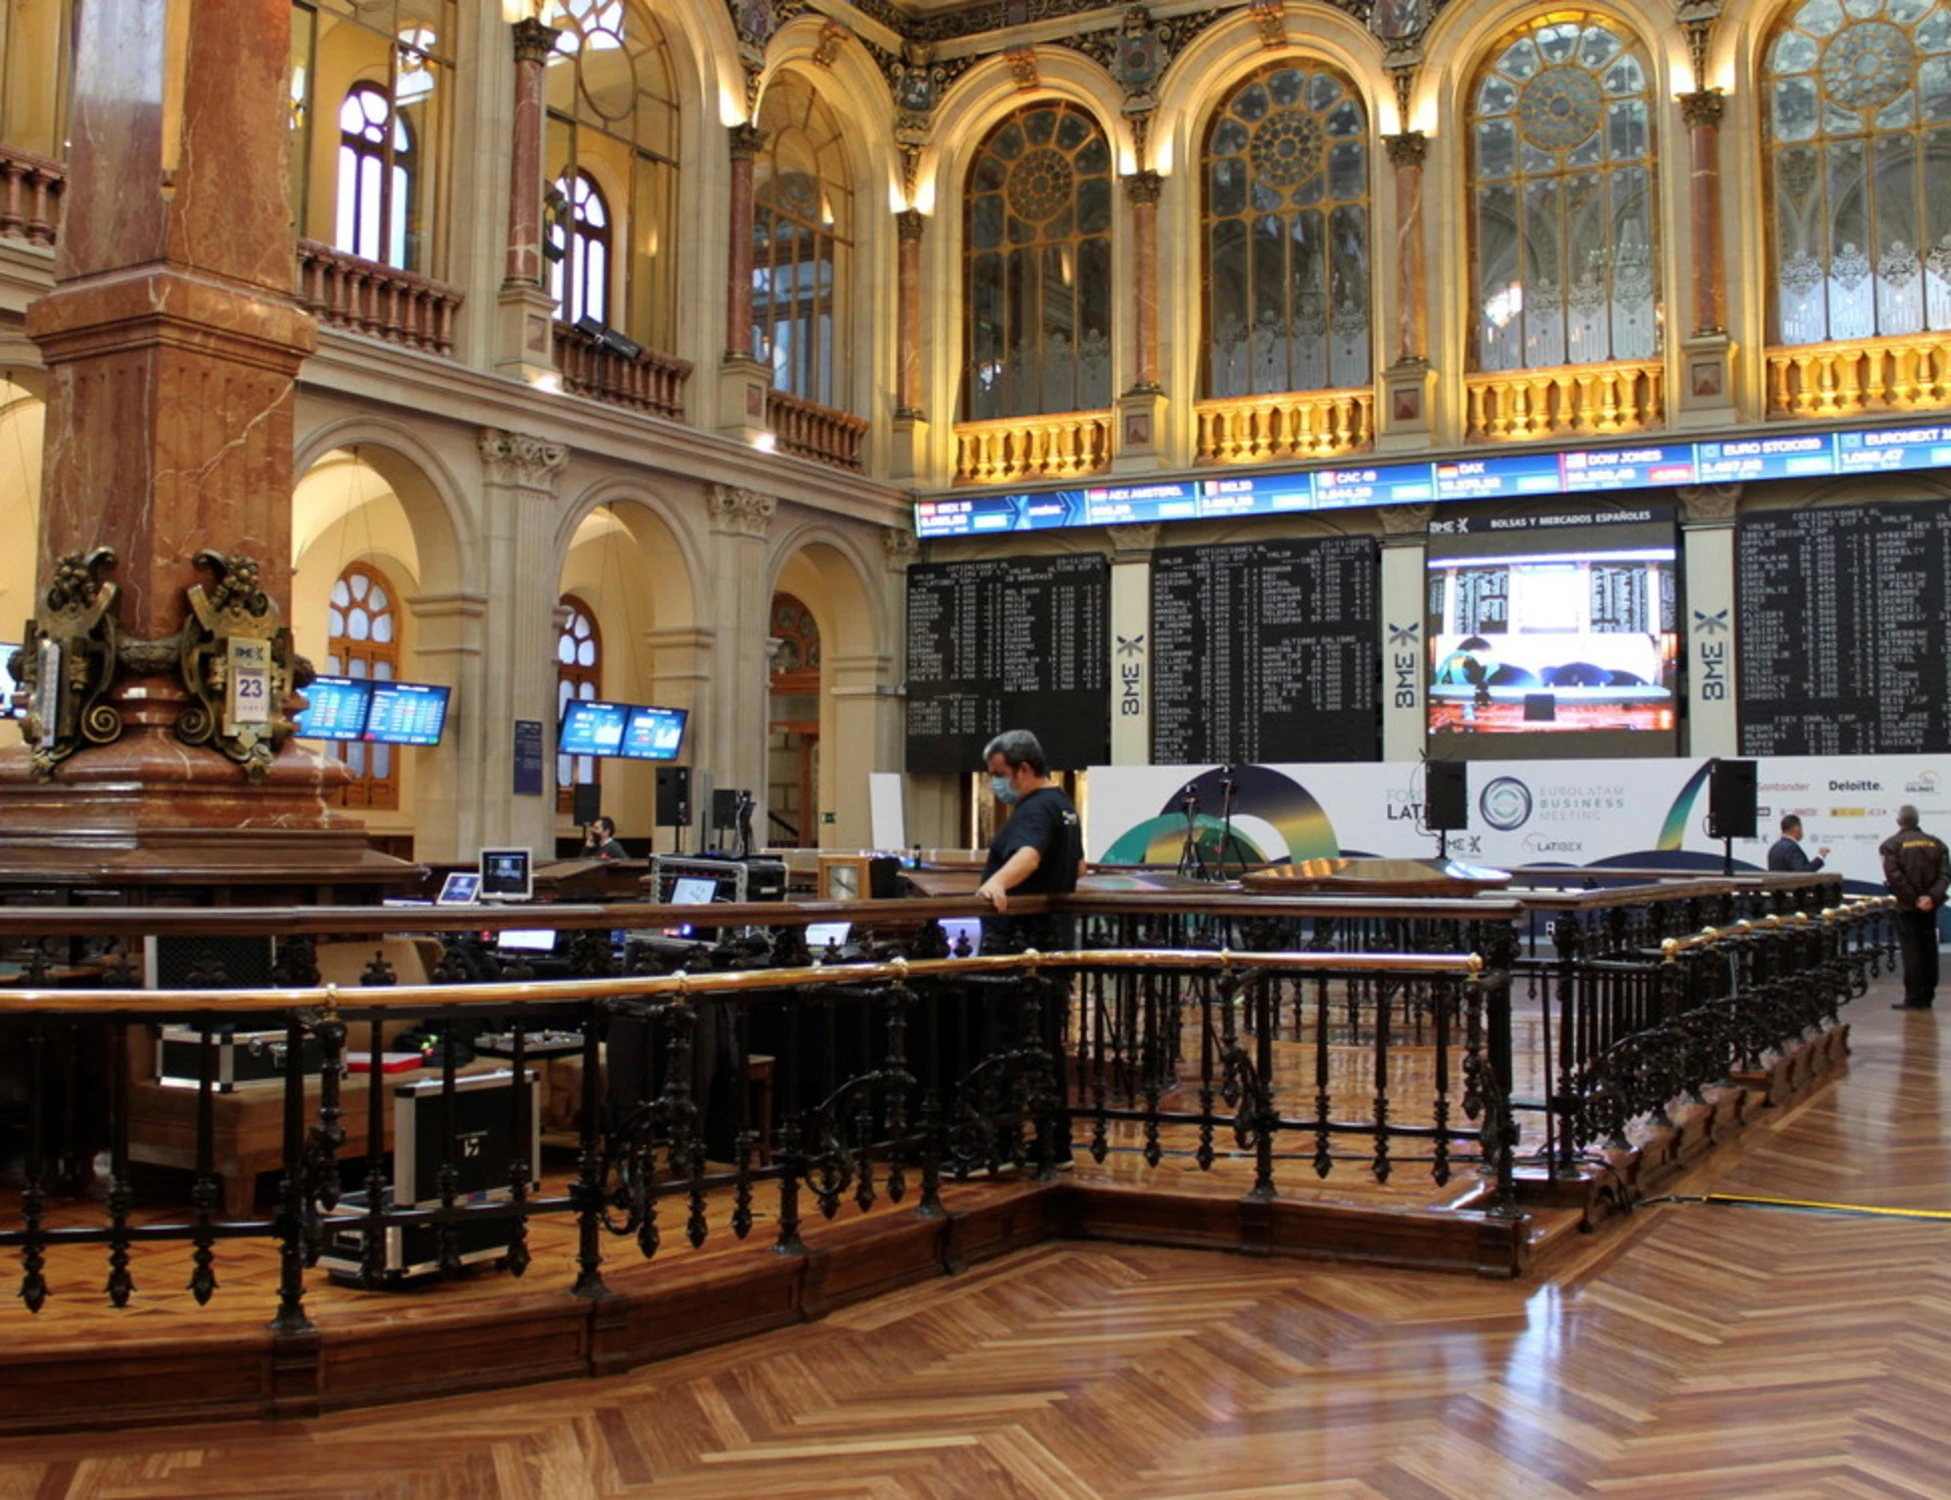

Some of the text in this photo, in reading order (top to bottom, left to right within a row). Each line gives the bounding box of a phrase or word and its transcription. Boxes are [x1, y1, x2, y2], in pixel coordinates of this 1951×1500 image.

[1491, 517, 1527, 529] BOLSAS
[1530, 516, 1537, 526] Y
[1539, 514, 1592, 526] MERCADOS
[1595, 510, 1652, 523] ESPAÑOLES
[1395, 652, 1415, 708] BME
[1701, 641, 1724, 701] BME
[240, 679, 262, 698] 23
[1122, 663, 1140, 716] BME
[1539, 786, 1624, 797] EUROLATAM
[1539, 798, 1625, 809] BUSINESS
[1539, 810, 1601, 821] MEETING
[1537, 841, 1582, 852] LATIBEX
